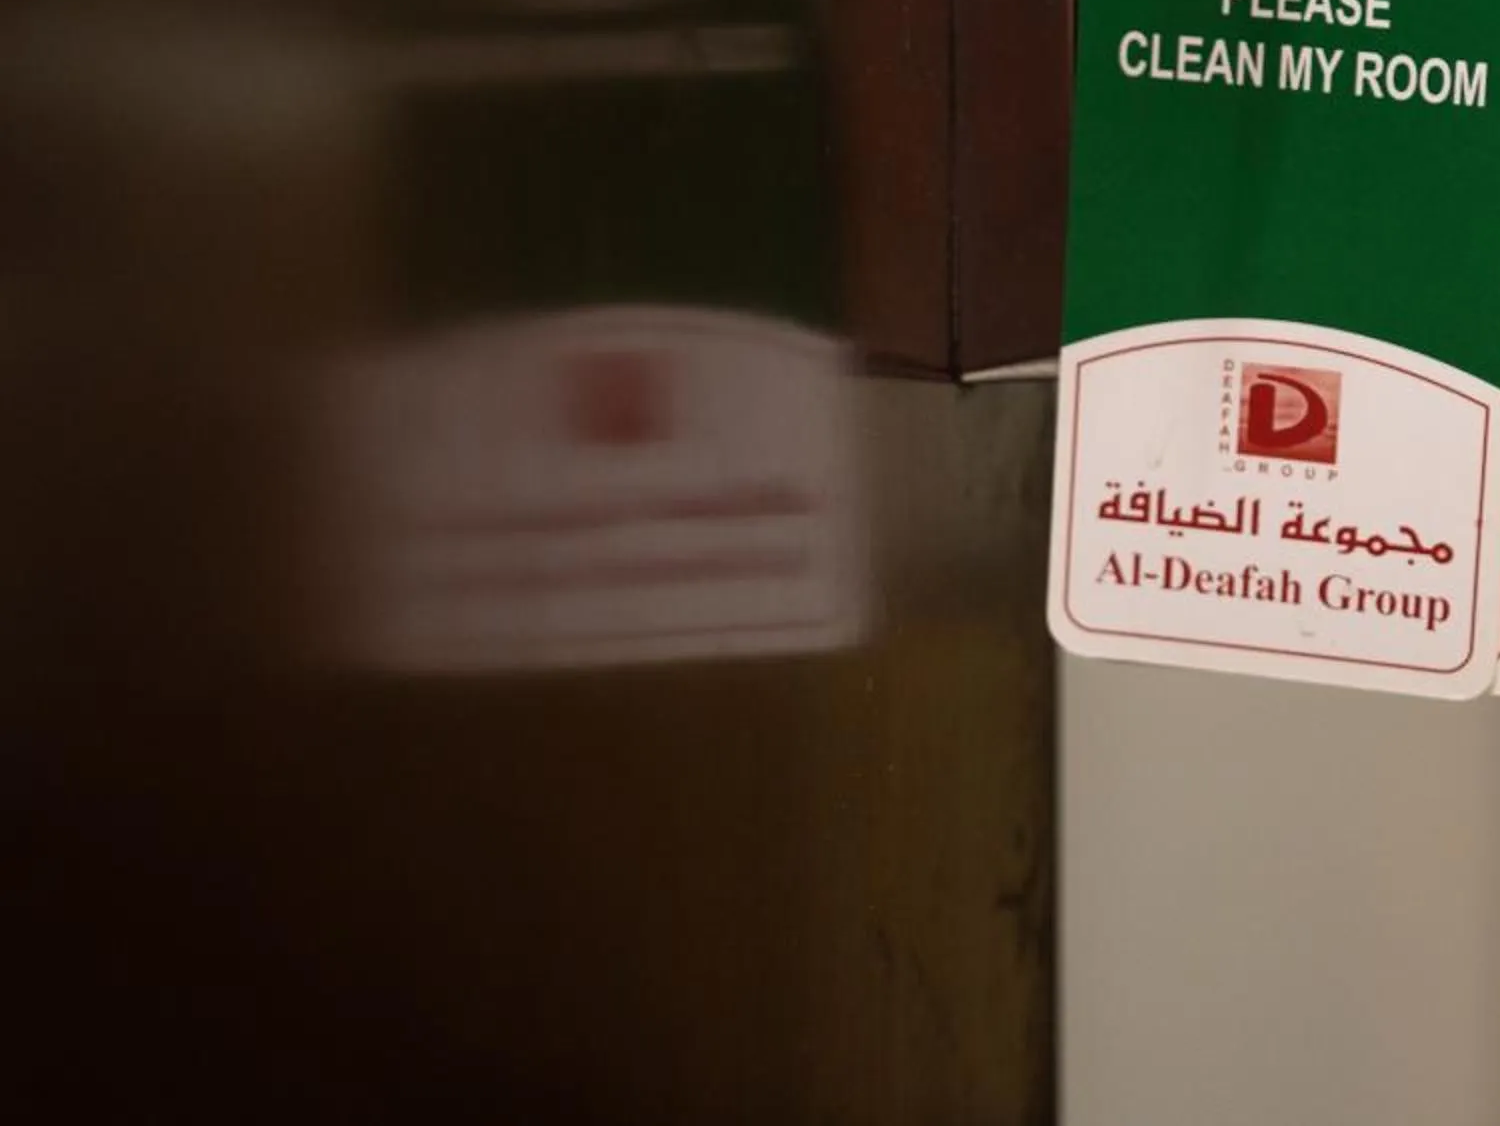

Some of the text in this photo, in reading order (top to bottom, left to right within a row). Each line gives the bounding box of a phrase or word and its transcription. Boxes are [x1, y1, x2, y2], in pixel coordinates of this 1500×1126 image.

[1118, 31, 1488, 107] CLEAN MY ROOM
[1219, 359, 1234, 454] DEAFAH
[1233, 460, 1338, 481] GROUP
[1097, 481, 1454, 565] مجموعة الضيافة
[1096, 550, 1451, 631] Al-Deafah Group
